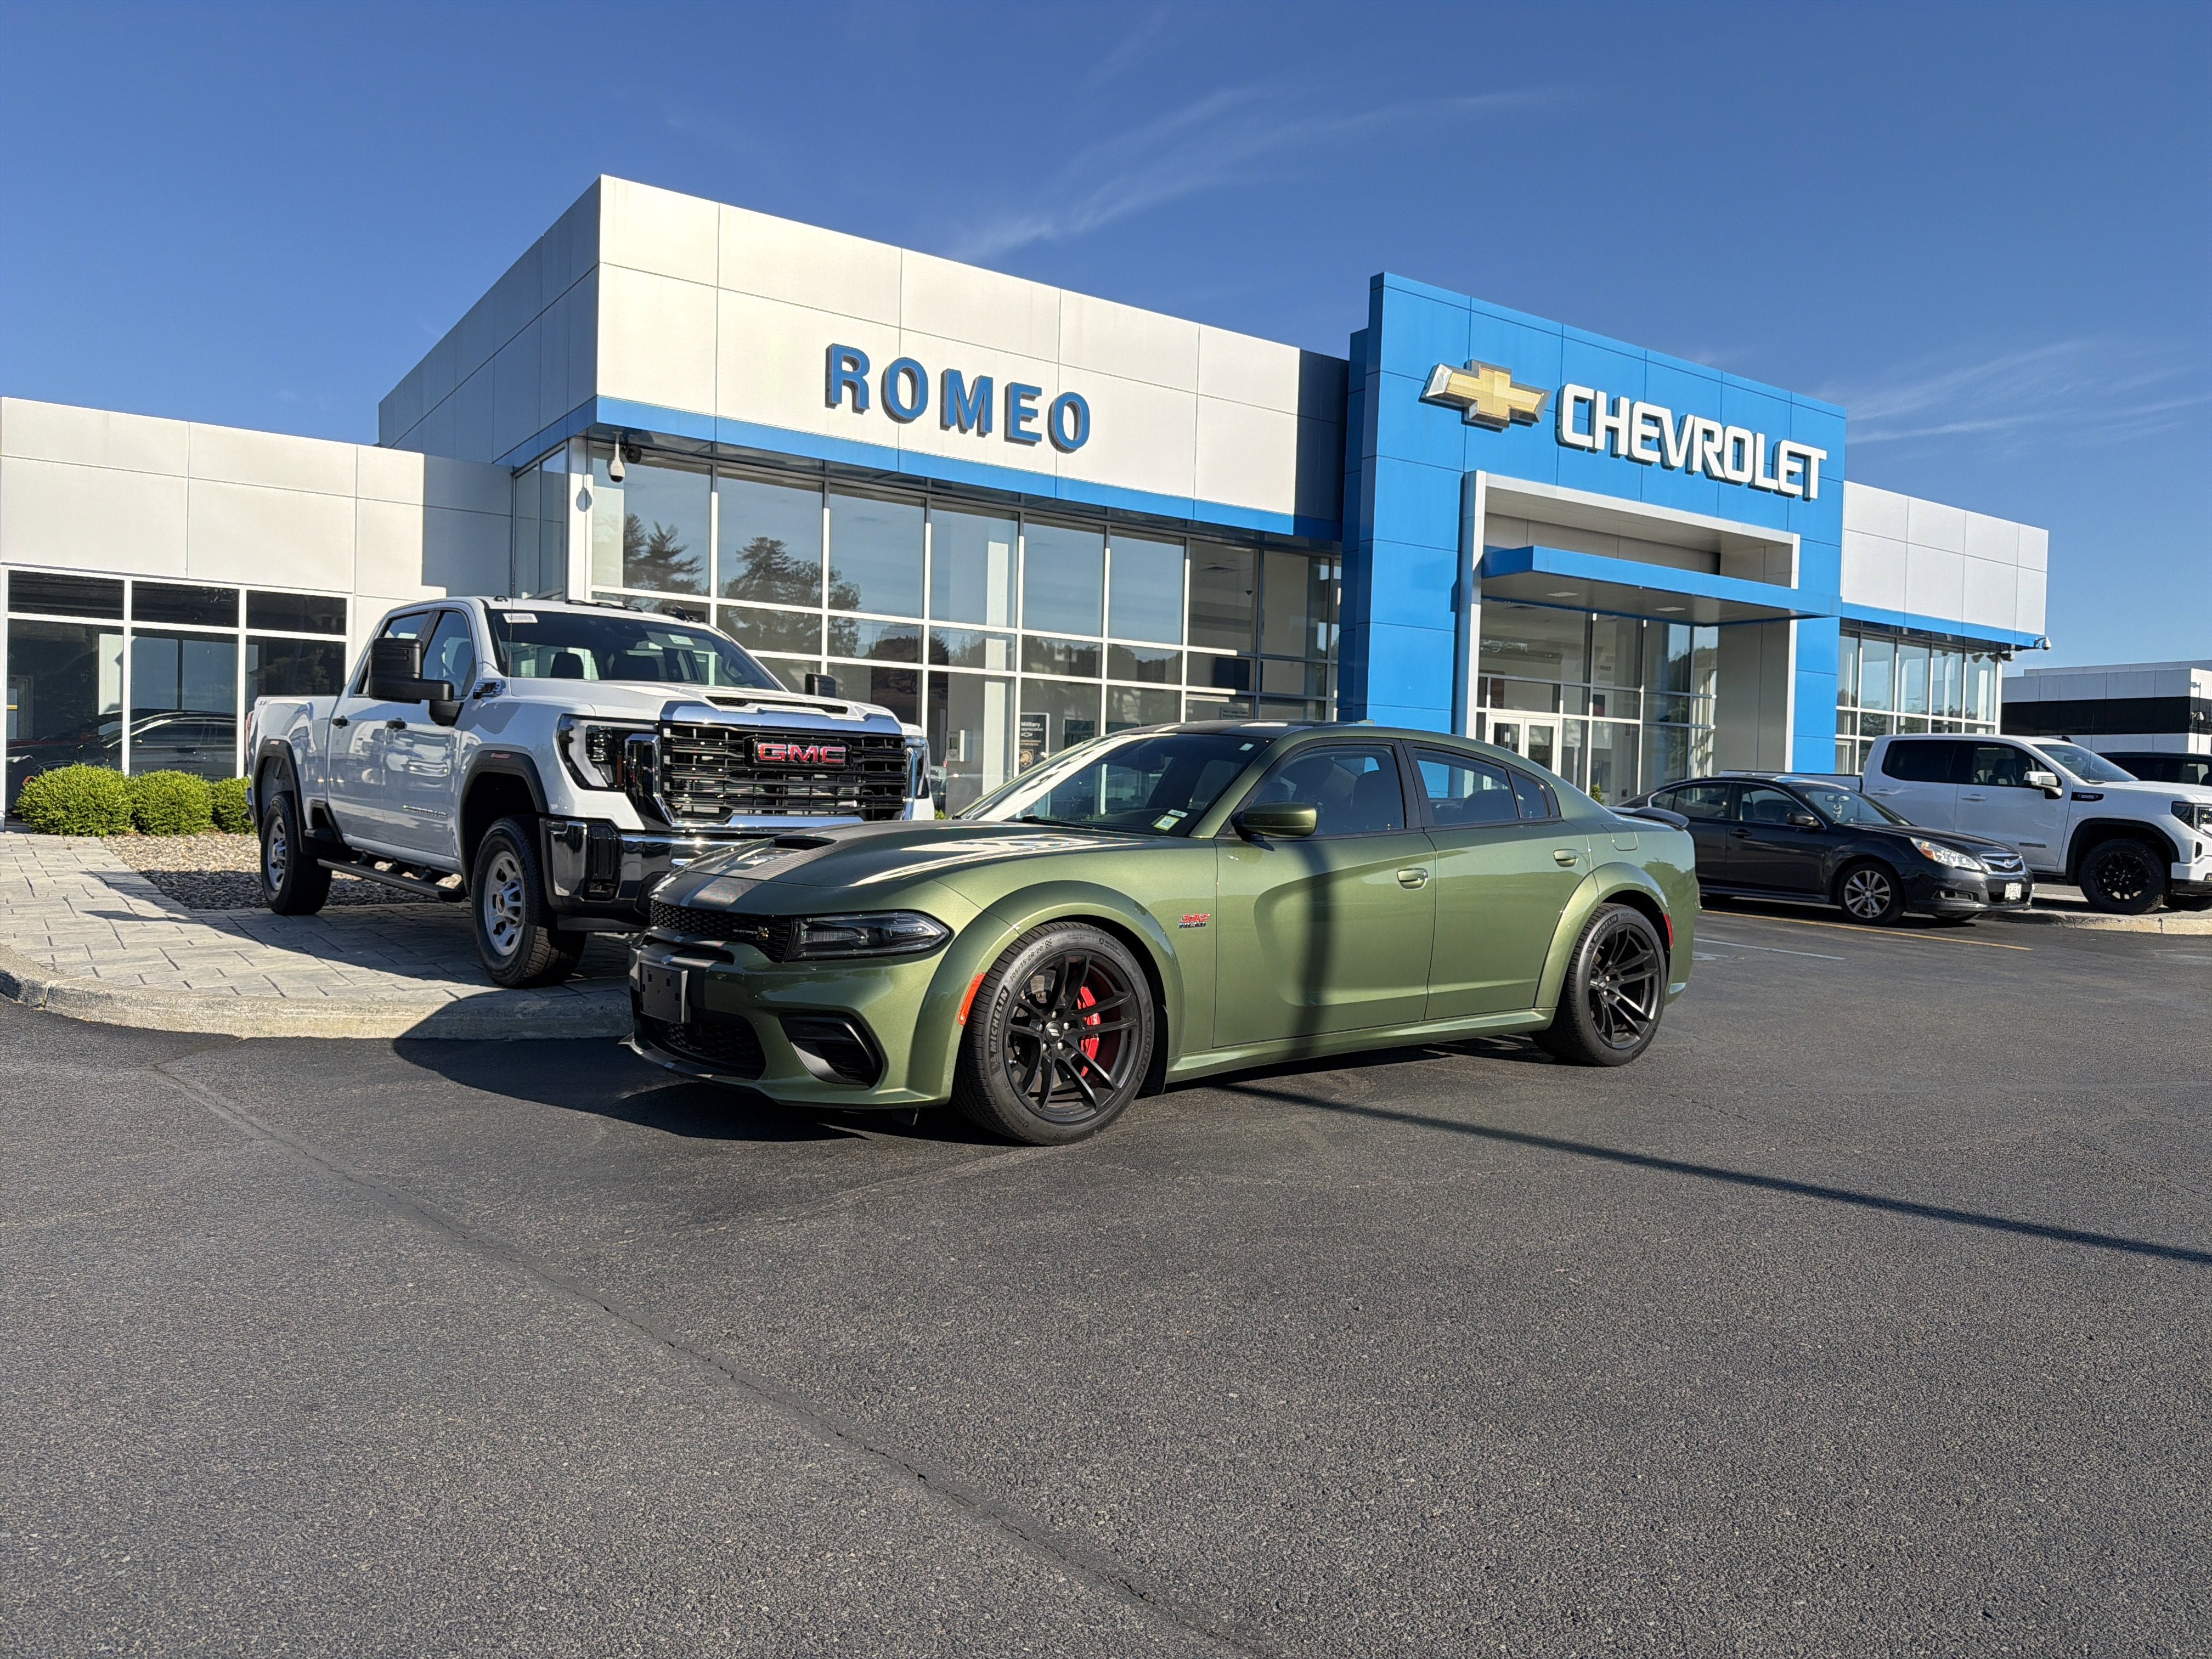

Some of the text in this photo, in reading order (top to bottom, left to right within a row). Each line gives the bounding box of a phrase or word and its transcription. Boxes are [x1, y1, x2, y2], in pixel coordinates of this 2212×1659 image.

[825, 343, 1091, 454] ROMEO
[1557, 383, 1827, 501] CHEVROLET
[757, 742, 847, 764] GMC
[1593, 915, 1618, 943] MICHELIN
[990, 988, 1009, 1053] MICHELIN
